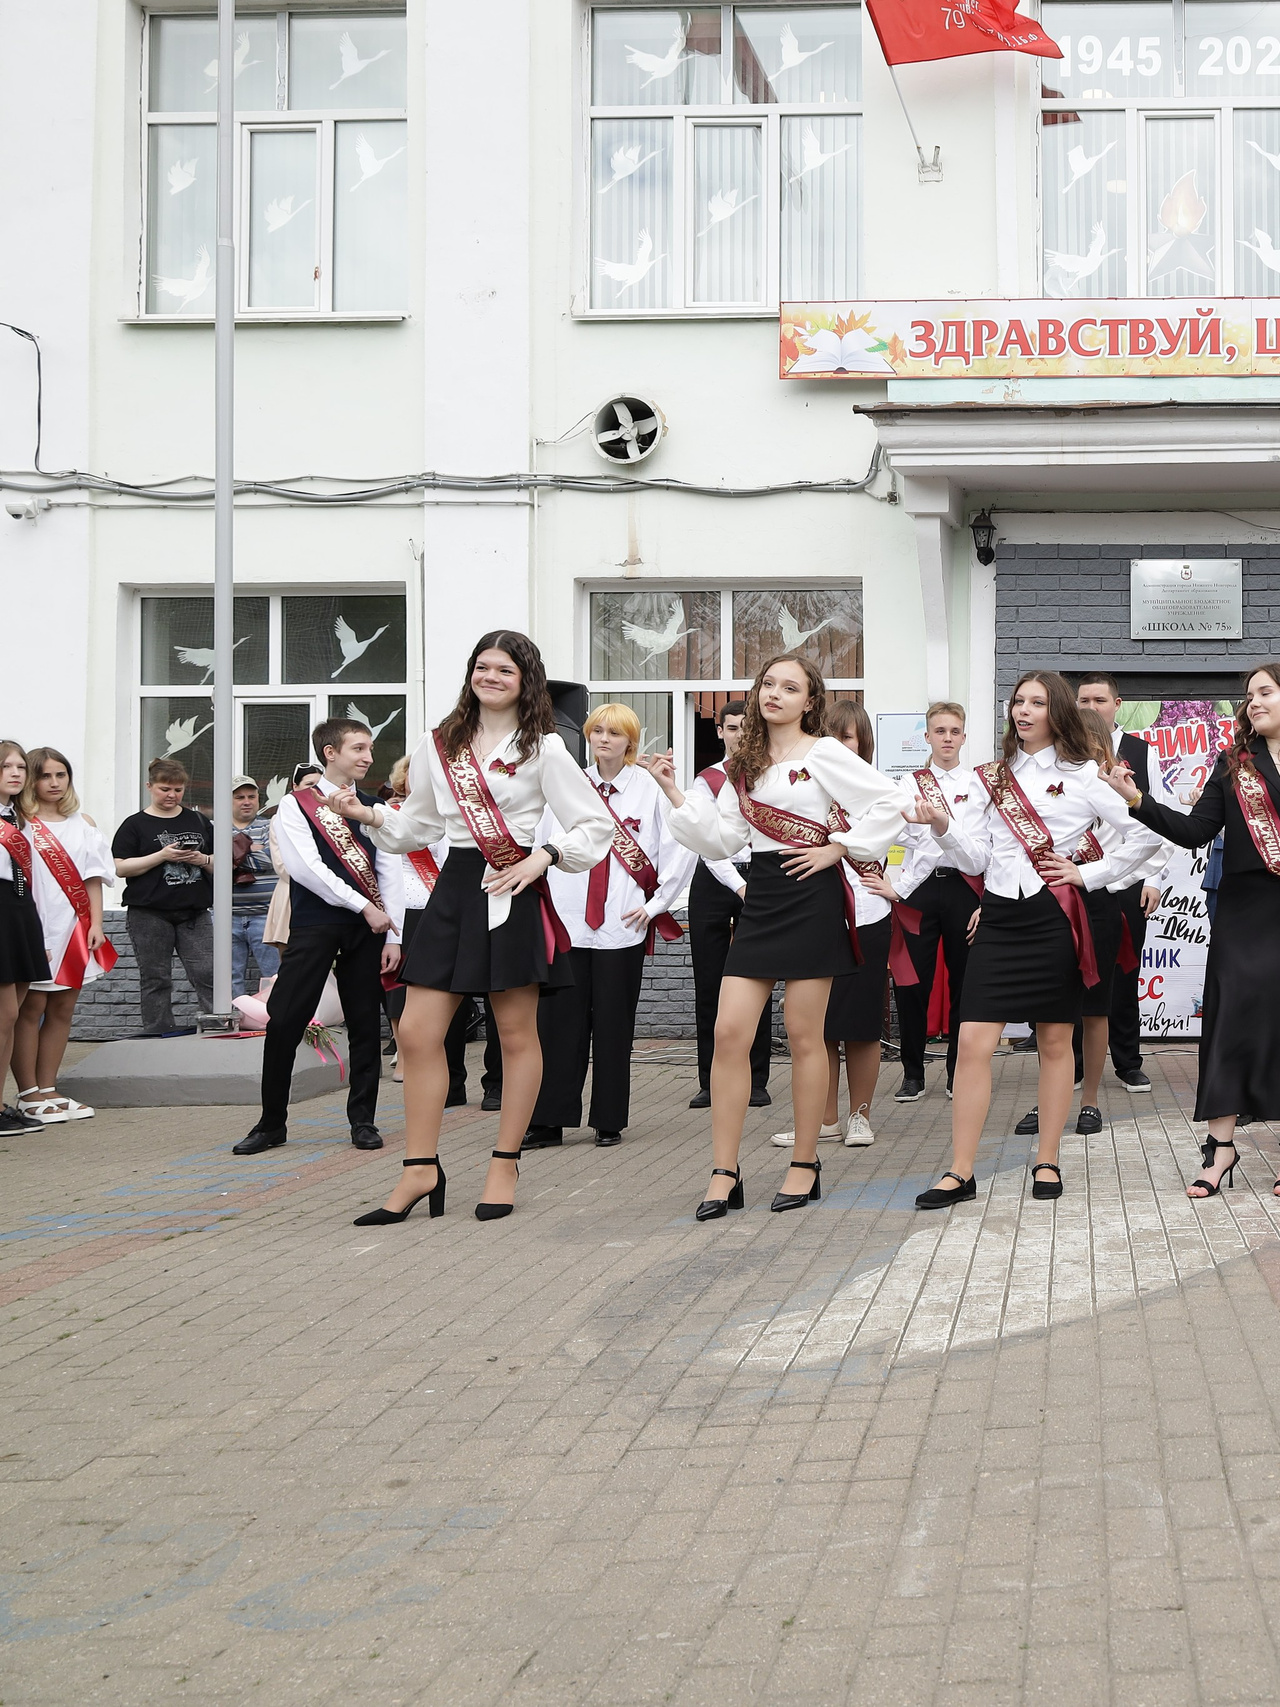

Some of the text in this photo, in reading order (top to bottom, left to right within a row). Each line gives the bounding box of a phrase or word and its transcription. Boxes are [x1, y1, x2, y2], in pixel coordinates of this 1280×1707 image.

[941, 7, 966, 30] 79
[1055, 35, 1162, 77] 1945
[909, 307, 1238, 365] ЗДРАВСТВУЙ,
[1141, 622, 1232, 632] «ШКОЛА № 75»
[449, 761, 499, 844] Выпускник
[324, 825, 378, 889] Выпускник
[613, 838, 651, 872] 2025
